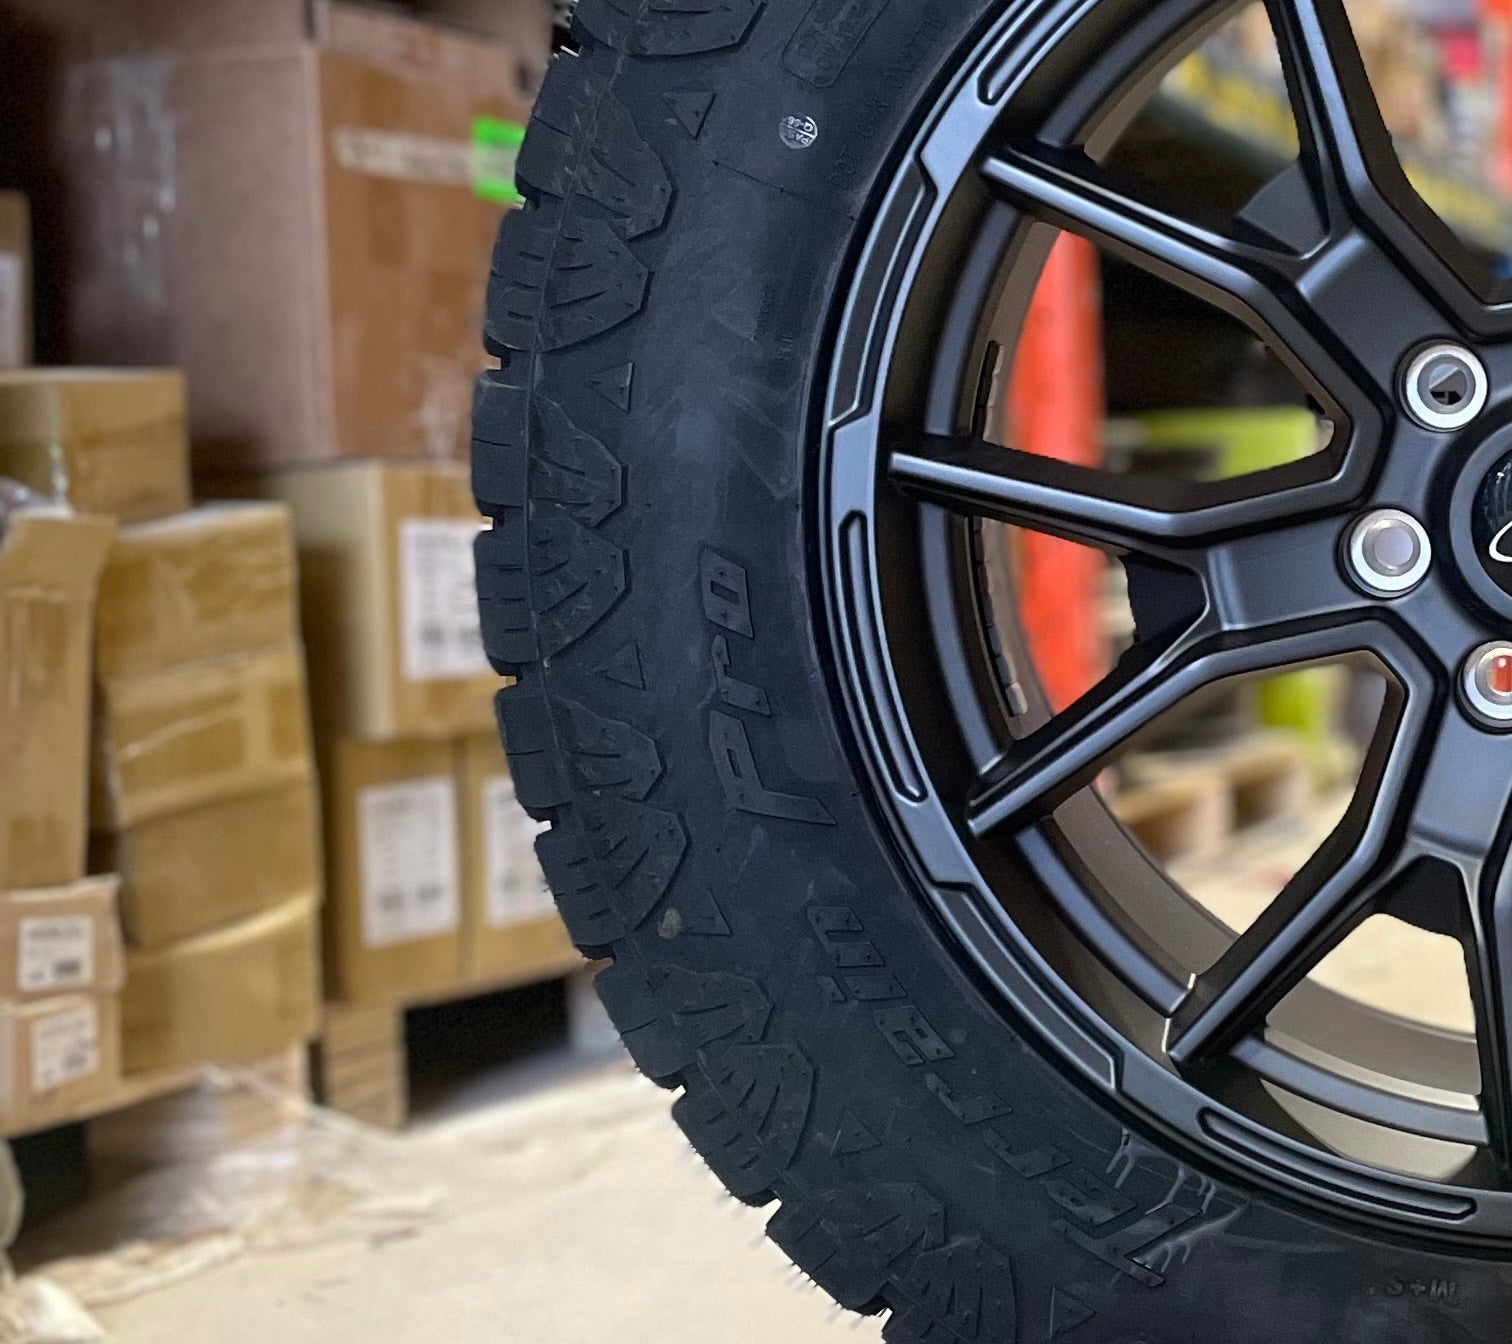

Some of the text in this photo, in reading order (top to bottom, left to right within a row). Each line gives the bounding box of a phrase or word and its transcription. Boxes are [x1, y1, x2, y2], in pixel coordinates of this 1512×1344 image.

[699, 548, 1201, 1287] Terrain Pro
[1382, 1267, 1456, 1305] M+S
